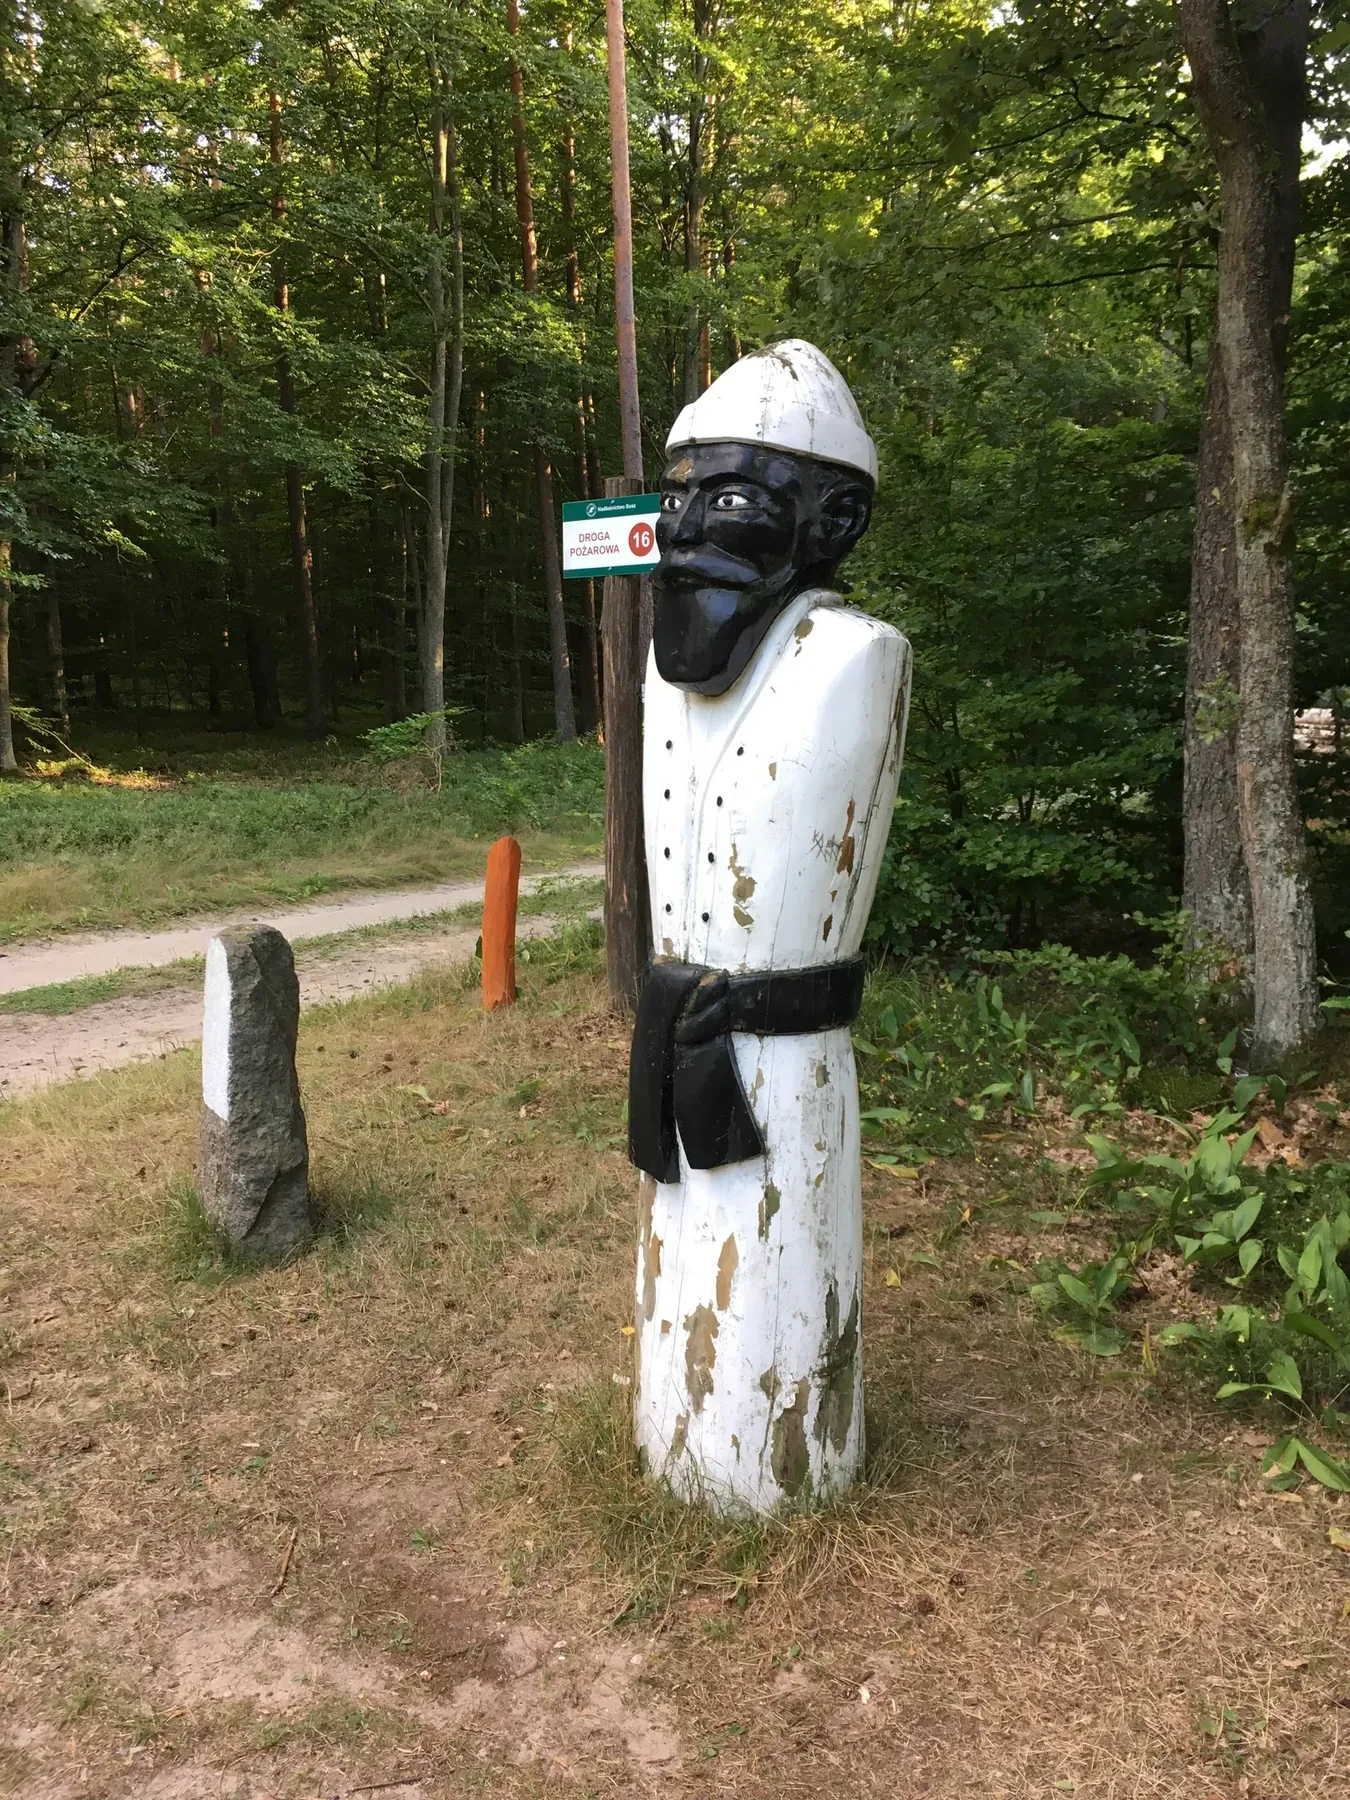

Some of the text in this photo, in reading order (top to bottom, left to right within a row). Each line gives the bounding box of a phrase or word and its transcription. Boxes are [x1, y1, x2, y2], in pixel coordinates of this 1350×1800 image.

[579, 531, 610, 542] DROGA
[633, 531, 650, 547] 16
[570, 544, 619, 556] POŻAROWA
